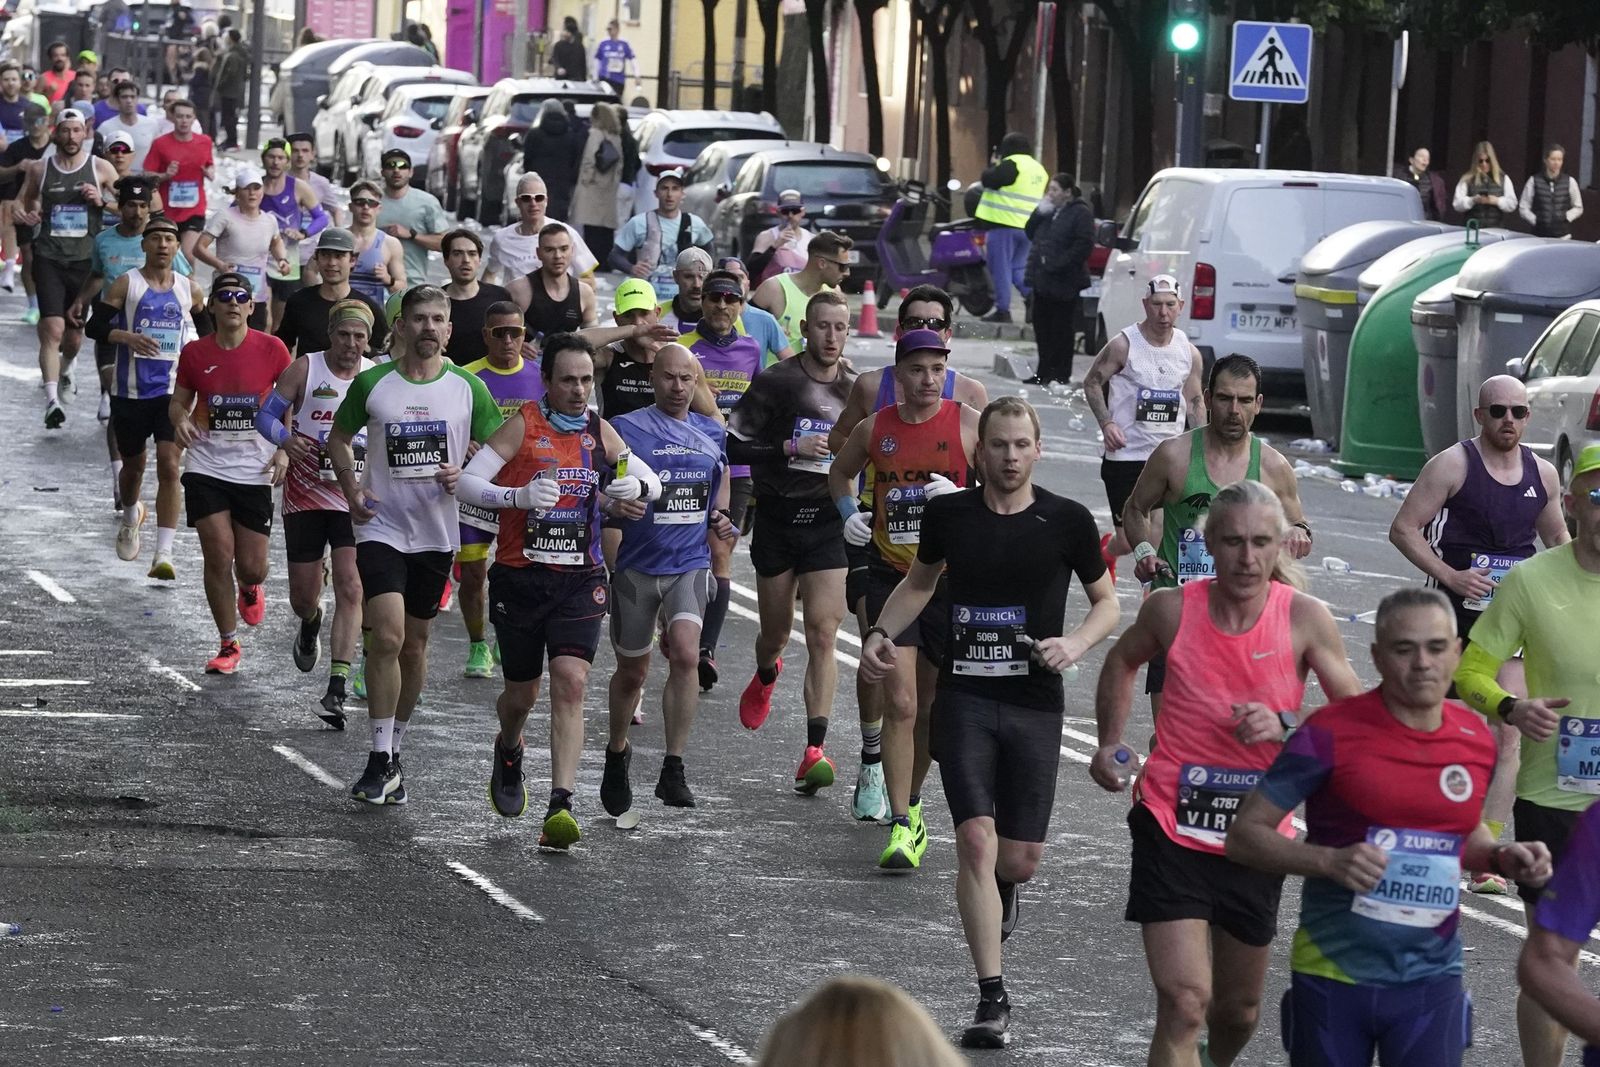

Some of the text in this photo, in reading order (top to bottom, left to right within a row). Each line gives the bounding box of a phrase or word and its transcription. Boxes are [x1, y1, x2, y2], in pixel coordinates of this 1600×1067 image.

[152, 320, 176, 329] ZURICH
[1239, 315, 1298, 329] 9177 MFY
[616, 385, 638, 393] PUERTO
[227, 410, 243, 418] 4742
[1146, 411, 1170, 421] KEITH
[215, 419, 255, 430] SAMUEL
[405, 424, 440, 433] ZURICH
[814, 421, 833, 431] ZUR
[407, 441, 426, 450] 3977
[393, 451, 442, 465] THOMAS
[675, 471, 707, 479] ZURICH
[675, 487, 693, 496] 4791
[905, 489, 925, 498] ZUR
[666, 499, 701, 511] ANGEL
[459, 502, 494, 521] EDUARDO
[549, 510, 581, 519] ZURICH
[548, 527, 565, 536] 4911
[888, 521, 905, 532] ALE
[532, 537, 578, 551] JUANCA
[1179, 562, 1209, 573] PEDRO
[1492, 559, 1520, 567] ZURIC
[975, 611, 1016, 621] ZURICH
[976, 632, 999, 642] 5069
[965, 645, 1013, 660] JULIEN
[1212, 772, 1261, 785] ZURICH
[1211, 797, 1240, 810] 4787
[1403, 835, 1456, 852] ZURICH
[1401, 863, 1430, 878] 5627
[1375, 879, 1455, 905] ARREIRO
